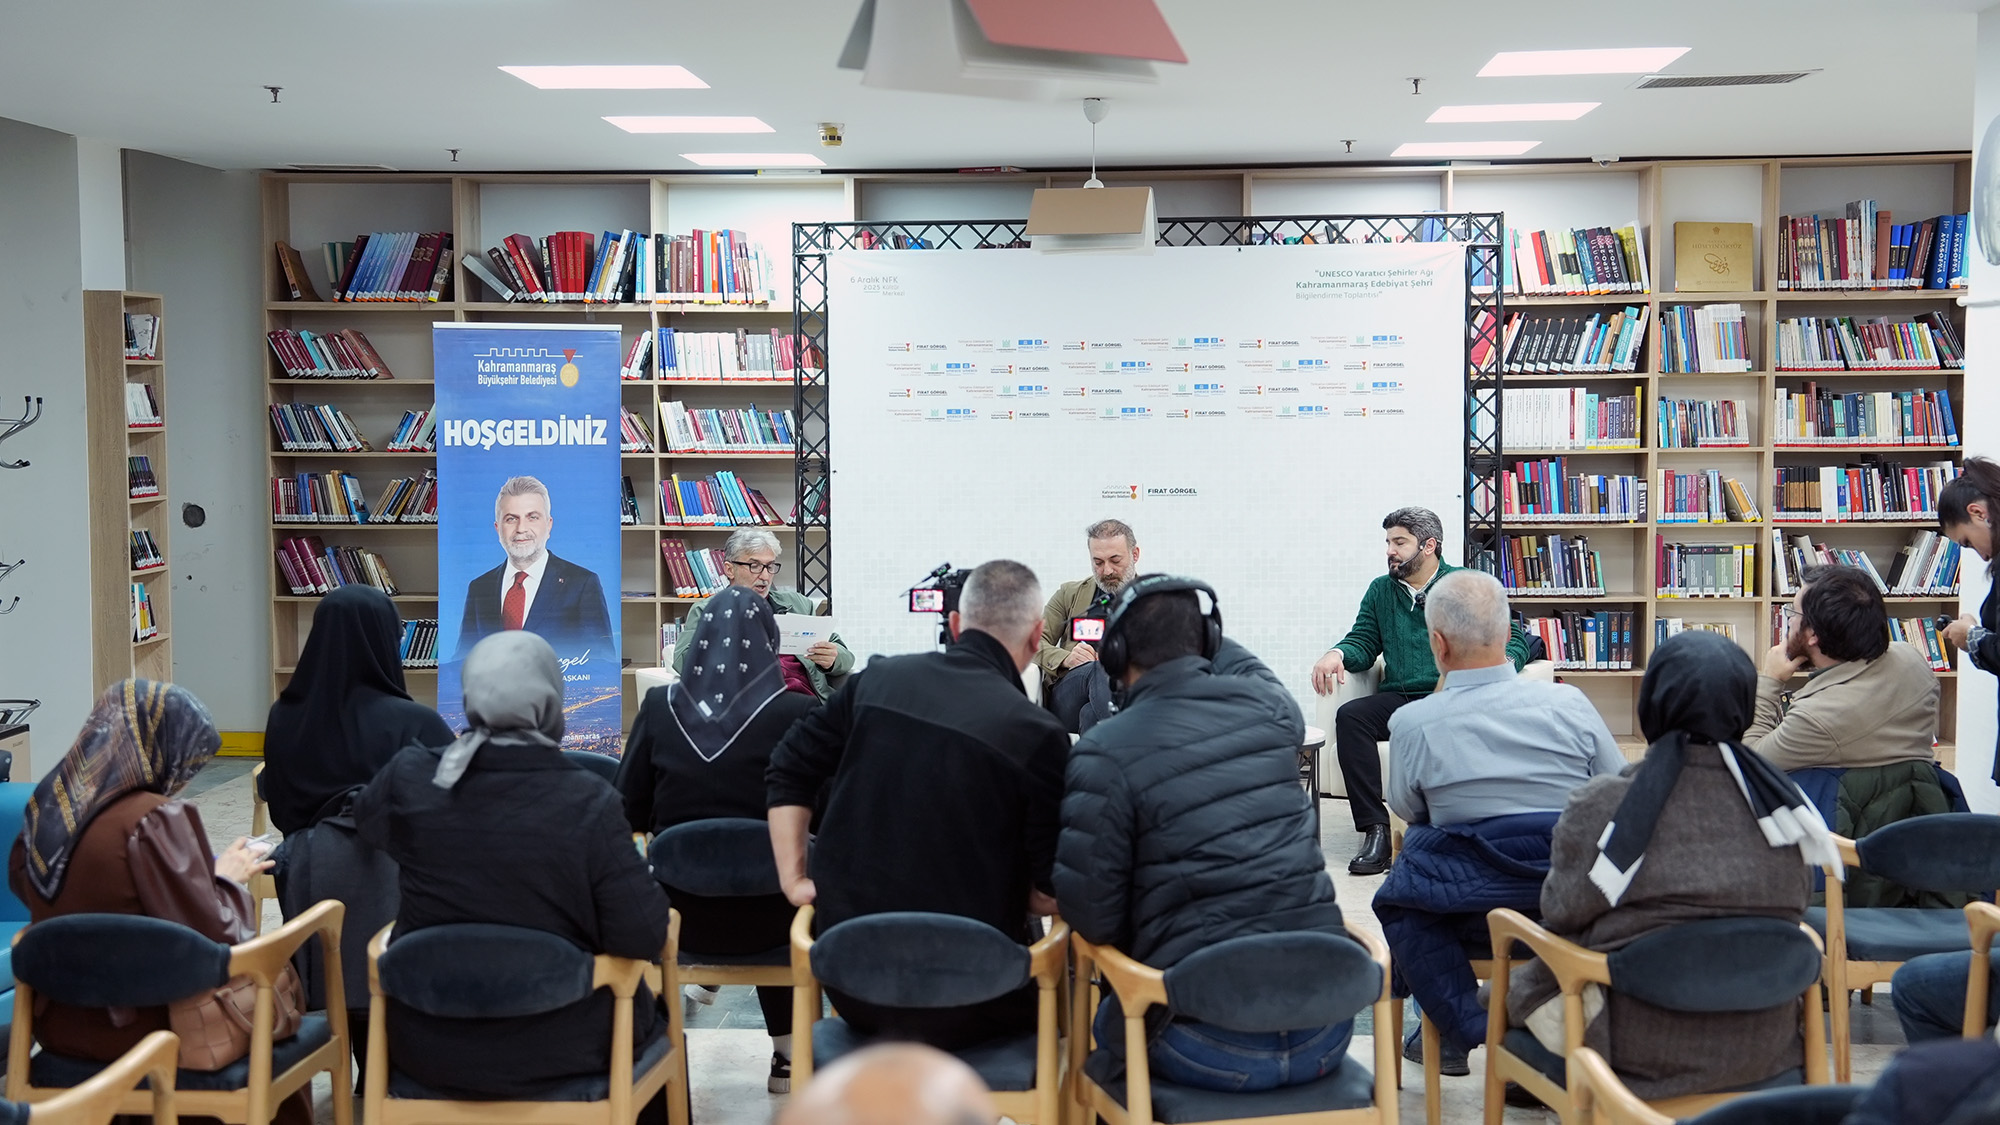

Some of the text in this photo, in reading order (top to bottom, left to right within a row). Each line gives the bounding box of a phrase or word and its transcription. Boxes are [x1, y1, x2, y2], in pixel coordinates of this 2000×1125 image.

[1388, 268, 1417, 278] Şehirler
[1296, 279, 1432, 290] Kahramanmaraş Edebiyat Şehri
[1296, 291, 1342, 300] Bilgilendirme
[478, 360, 557, 374] Kahramanmaraş
[478, 374, 558, 387] Büyükşehir Belediyesi
[444, 414, 608, 450] HOŞGELDİNİZ
[562, 674, 590, 682] AŞKANI
